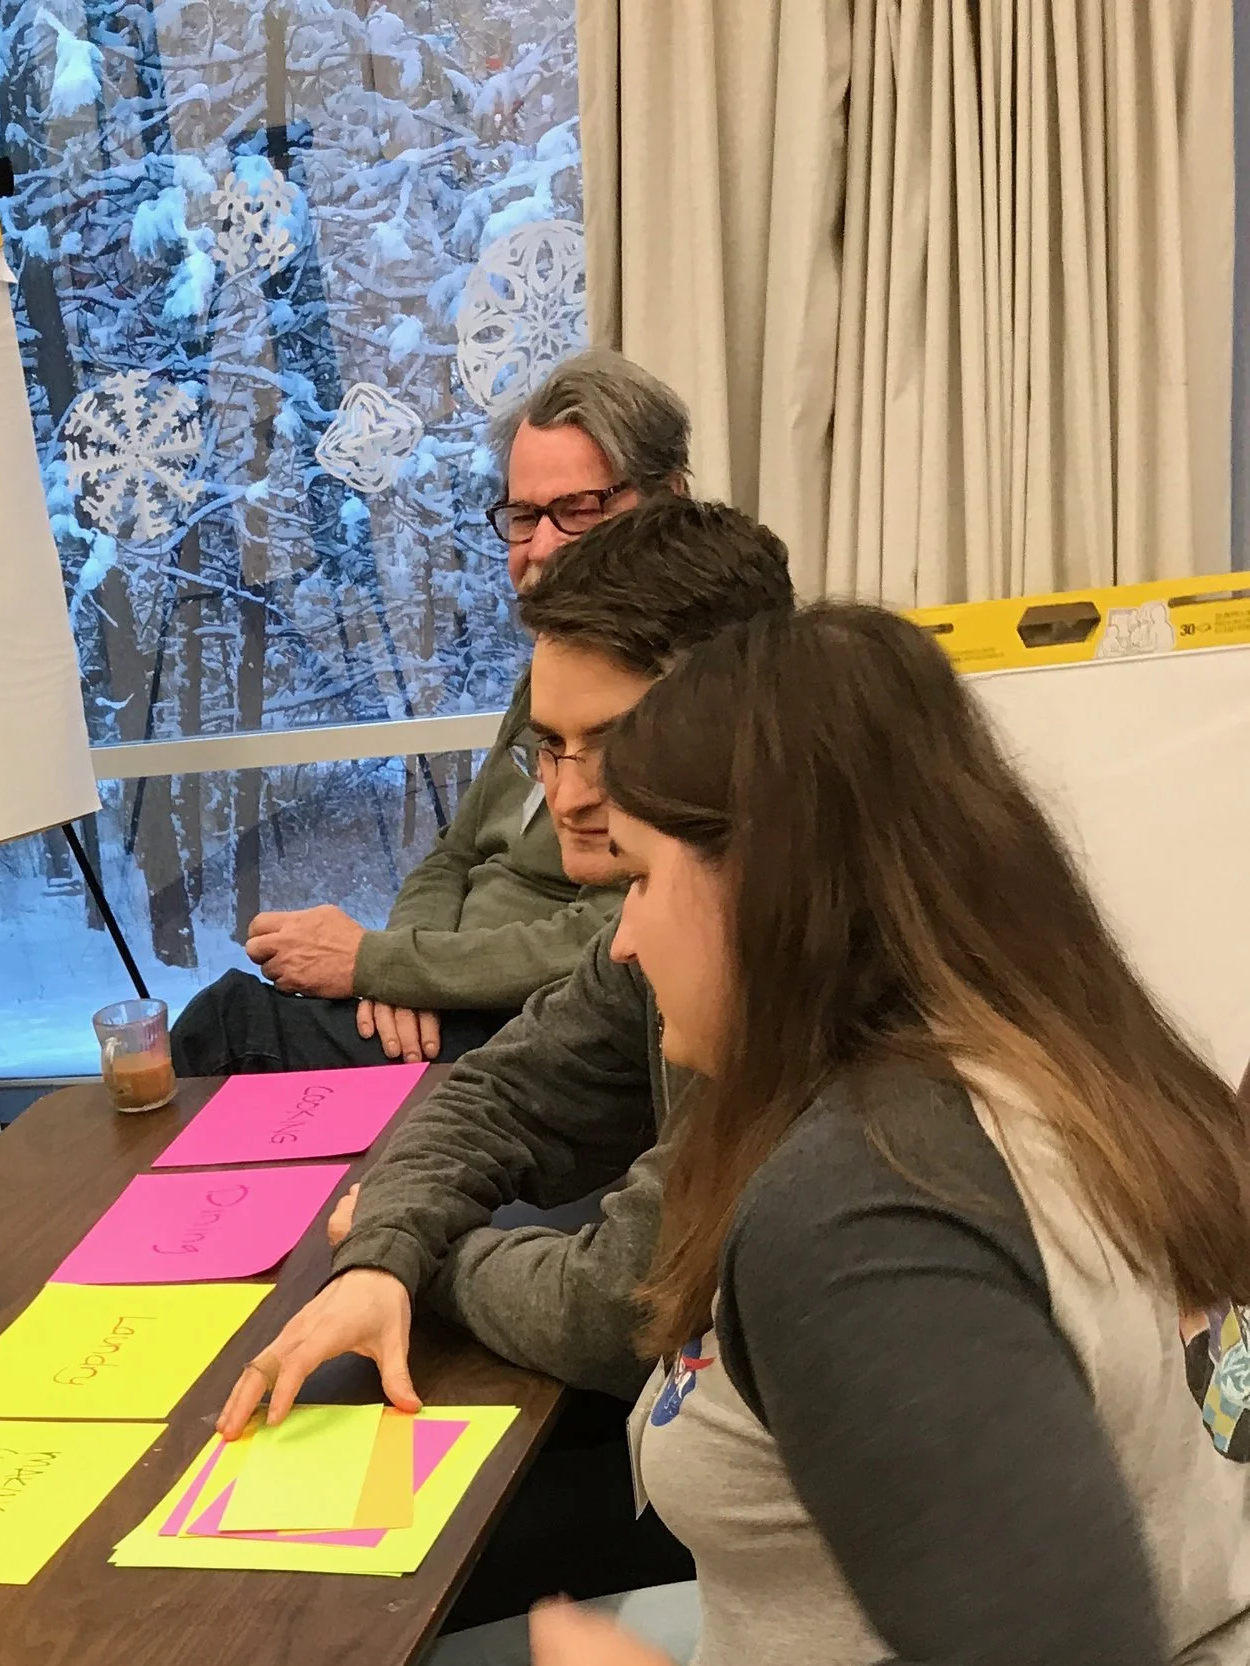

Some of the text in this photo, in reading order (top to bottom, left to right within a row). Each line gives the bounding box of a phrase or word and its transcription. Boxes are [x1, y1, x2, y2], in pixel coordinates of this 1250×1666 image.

[1179, 623, 1196, 637] 30
[152, 1183, 251, 1255] Dining
[52, 1315, 158, 1387] Laundry
